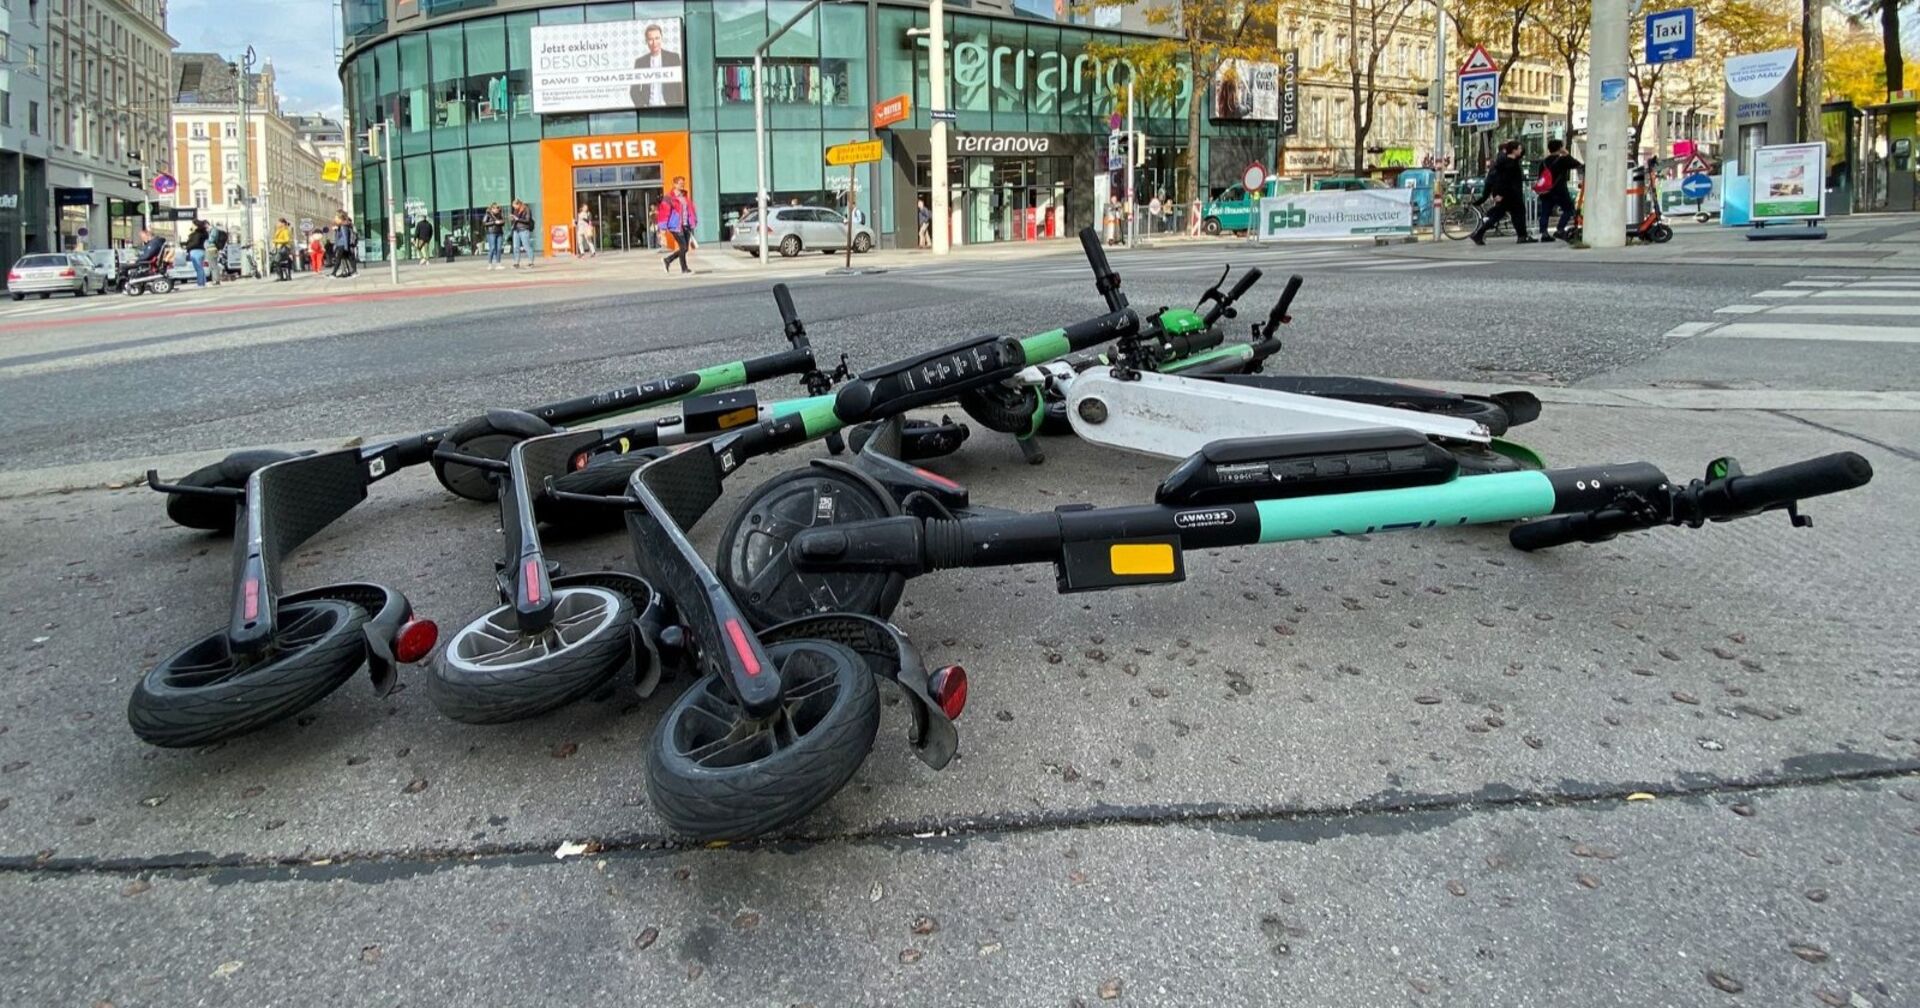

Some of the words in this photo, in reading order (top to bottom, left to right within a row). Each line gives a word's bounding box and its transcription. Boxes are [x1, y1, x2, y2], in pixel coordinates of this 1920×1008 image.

[1656, 21, 1682, 38] Taxi
[541, 42, 566, 54] Jetzt
[568, 39, 609, 51] exklusiv
[540, 52, 610, 70] DESIGNS
[541, 76, 579, 86] DAWID
[585, 71, 674, 83] TOMASZEWSKI
[1480, 97, 1491, 106] 20
[1738, 101, 1767, 111] DRINK
[1466, 111, 1490, 120] Zone
[572, 139, 658, 161] REITER
[1269, 203, 1306, 235] pb
[1182, 512, 1228, 522] SEGWAY
